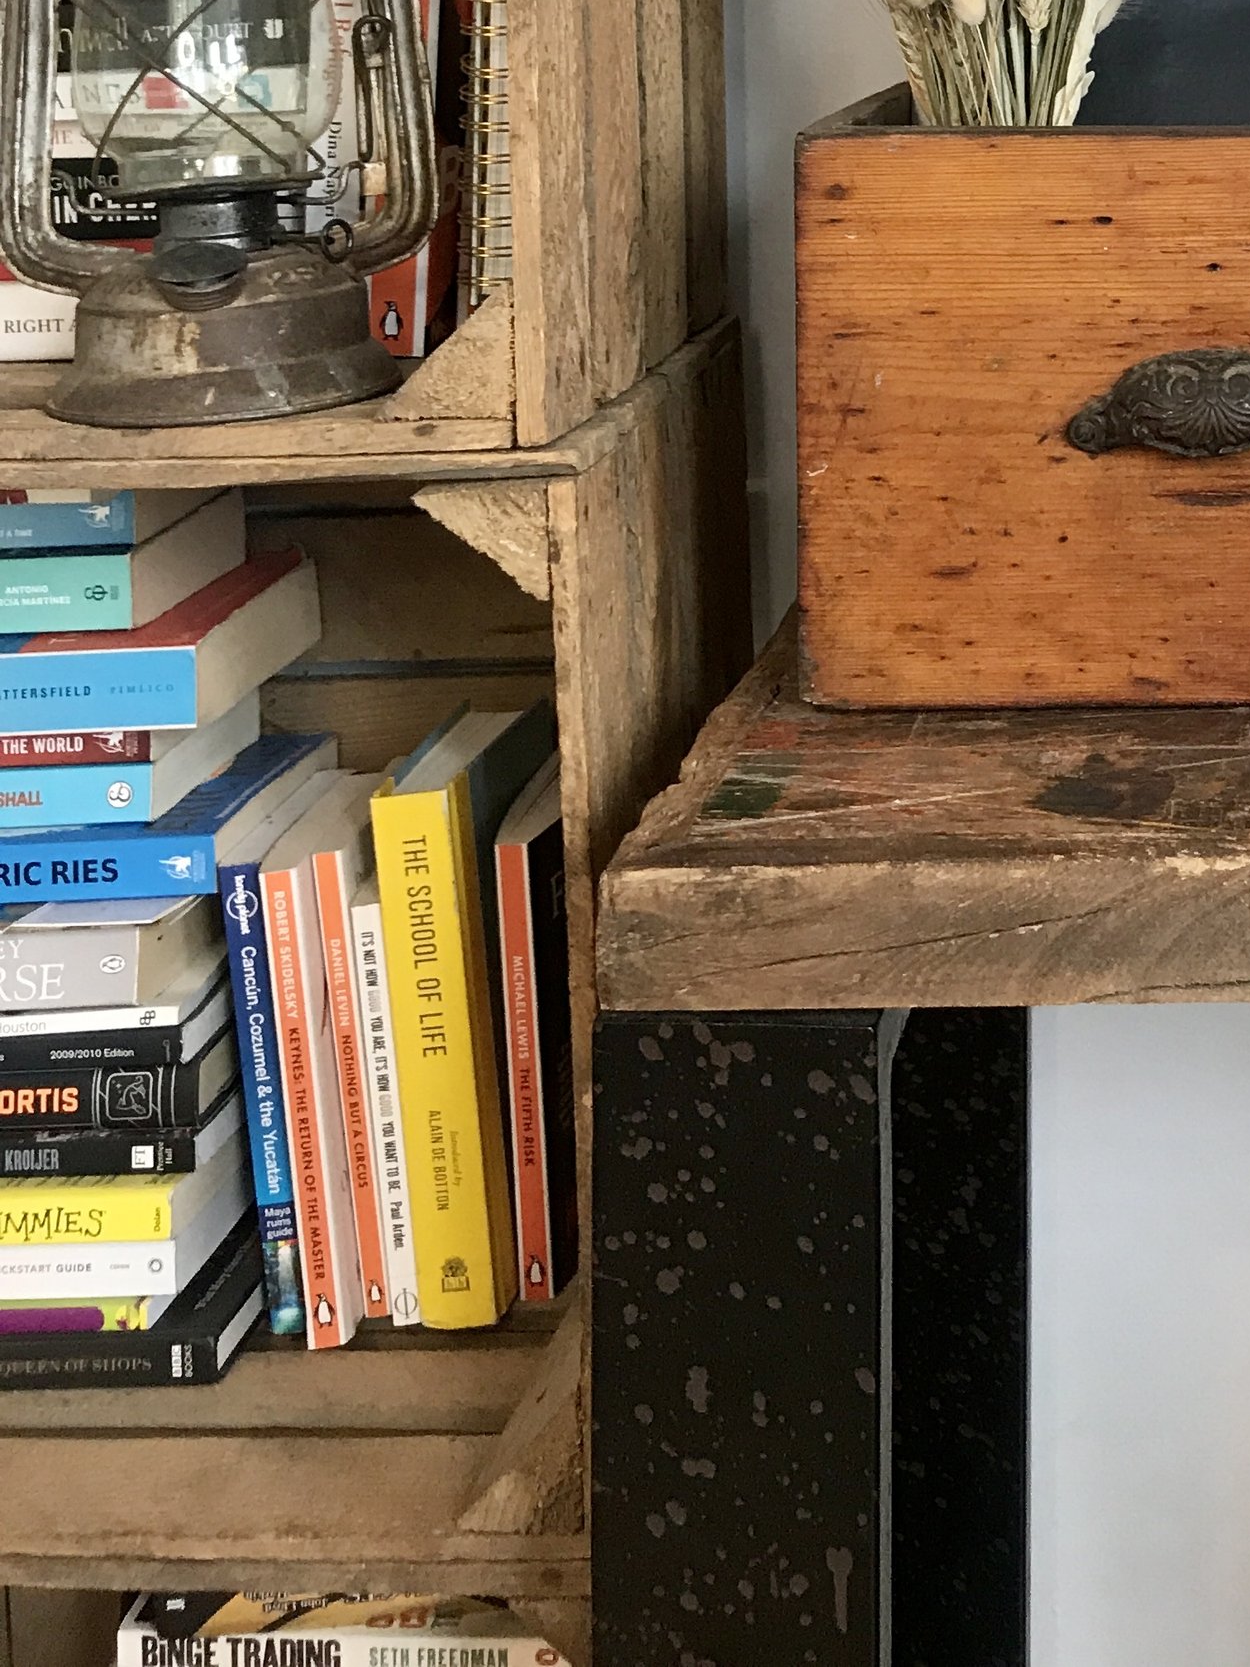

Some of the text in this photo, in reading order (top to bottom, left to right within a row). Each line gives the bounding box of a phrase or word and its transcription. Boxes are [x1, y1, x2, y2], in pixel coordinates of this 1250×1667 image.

[327, 121, 343, 159] Dina
[4, 318, 65, 334] RIGHT
[2, 736, 84, 755] THE WORLD
[51, 857, 119, 885] RIES
[234, 874, 252, 935] lonely planet
[273, 890, 290, 942] ROBERT
[363, 949, 377, 965] NOT
[402, 835, 448, 1058] THE SCHOOL OF LIFE
[278, 946, 299, 1019] SKIDELSKY
[365, 968, 378, 987] HOW
[370, 1015, 383, 1033] YOU
[50, 1048, 135, 1060] 2009/2010 Edition
[329, 937, 369, 1189] DANIEL LEVIN NOTHING BUT A CIRCUS
[513, 955, 536, 1167] MICHAEL LEWIS THE FIFTH RISK
[240, 946, 283, 1194] Cancún, Cozumel & the Yucatán
[377, 1074, 390, 1093] HOW
[0, 1086, 79, 1116] ORTIS
[295, 1089, 309, 1115] THE
[381, 1120, 395, 1138] YOU
[298, 1117, 315, 1171] RETURN
[384, 1140, 398, 1164] WANT
[5, 1148, 60, 1172] KROIJER
[386, 1166, 400, 1178] TO
[428, 1109, 450, 1212] ALAIN DE BOTTON
[305, 1174, 318, 1194] OF
[153, 1207, 161, 1232] Dolan
[264, 1206, 291, 1218] Maya
[307, 1197, 320, 1223] THE
[389, 1200, 404, 1220] Paul
[309, 1226, 326, 1281] MASTER
[56, 1263, 92, 1273] GUIDE
[184, 1344, 193, 1378] BOOKS
[226, 1636, 341, 1667] TRADING
[369, 1646, 410, 1667] SETH
[417, 1645, 509, 1667] FREEDMAN
